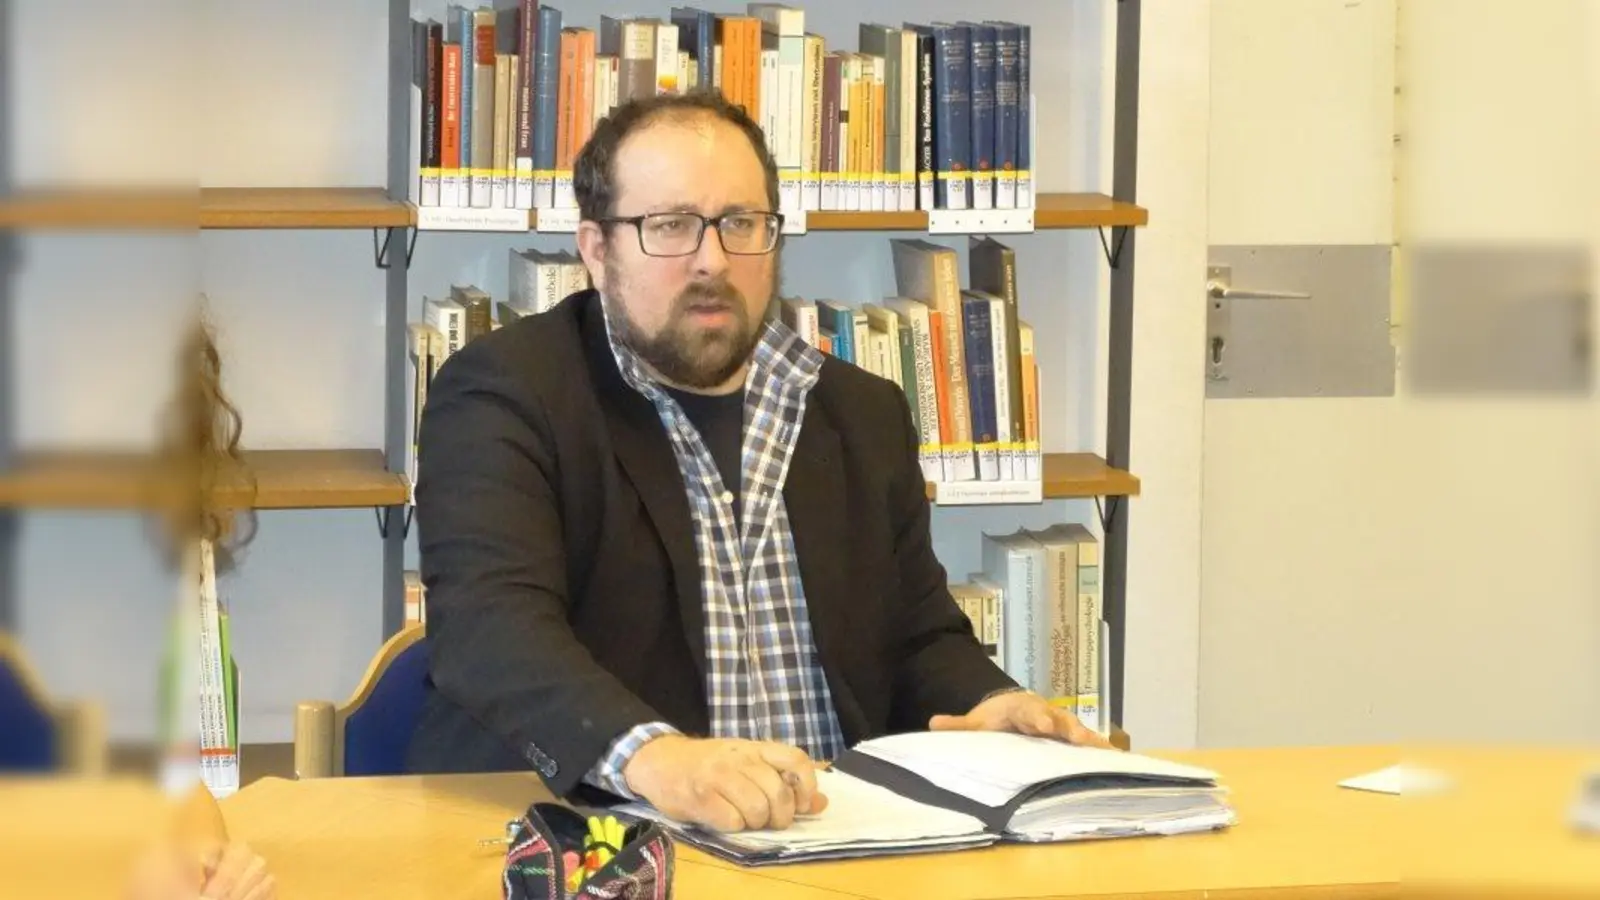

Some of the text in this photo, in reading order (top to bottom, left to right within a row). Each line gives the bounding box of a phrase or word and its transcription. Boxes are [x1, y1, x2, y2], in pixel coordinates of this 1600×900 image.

[923, 54, 933, 170] ACKER Das Faschismus-Syndrom
